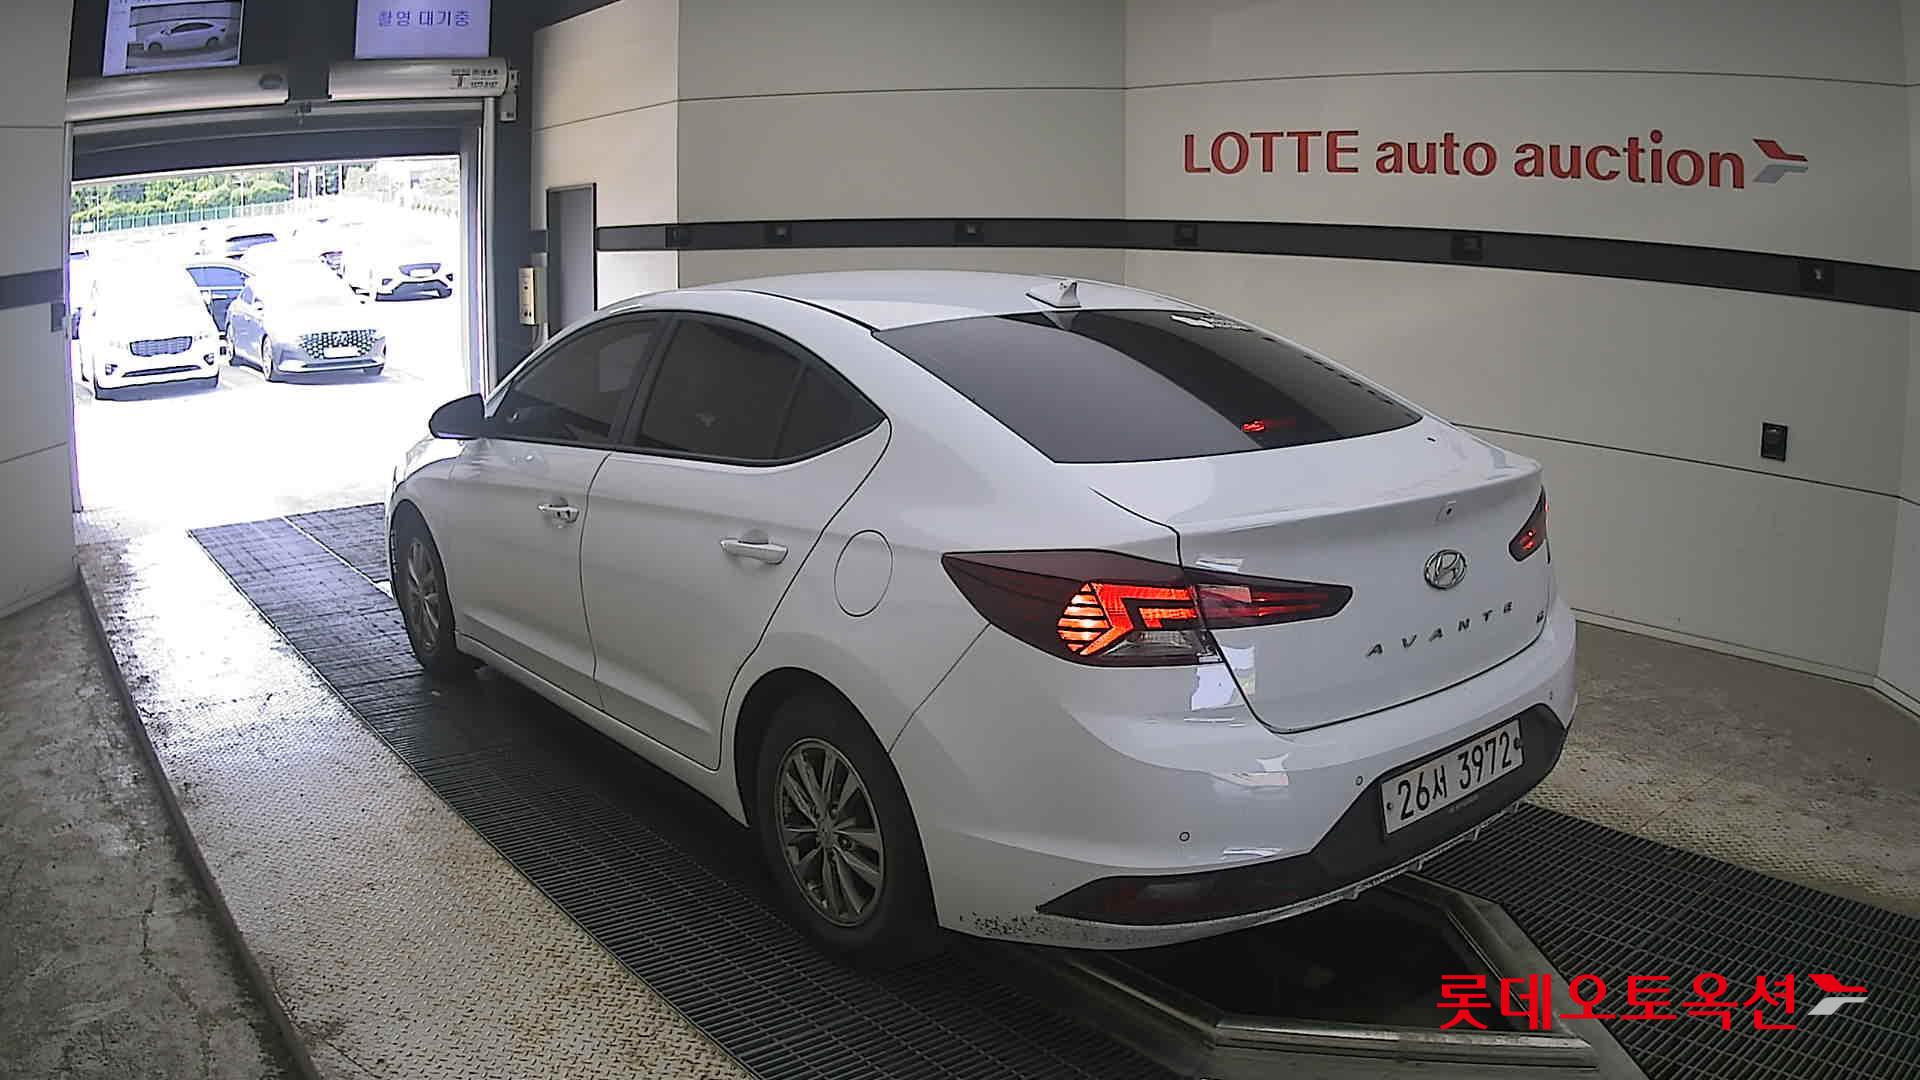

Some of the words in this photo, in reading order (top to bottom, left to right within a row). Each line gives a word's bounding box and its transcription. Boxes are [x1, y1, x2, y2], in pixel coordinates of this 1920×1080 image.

[418, 9, 472, 27] 대기중
[1184, 130, 1359, 175] LOTTE
[1377, 135, 1497, 176] auto
[1514, 131, 1744, 188] auction
[1366, 601, 1513, 657] AVANTE
[1397, 764, 1448, 821] 26서
[1457, 731, 1513, 790] 3972
